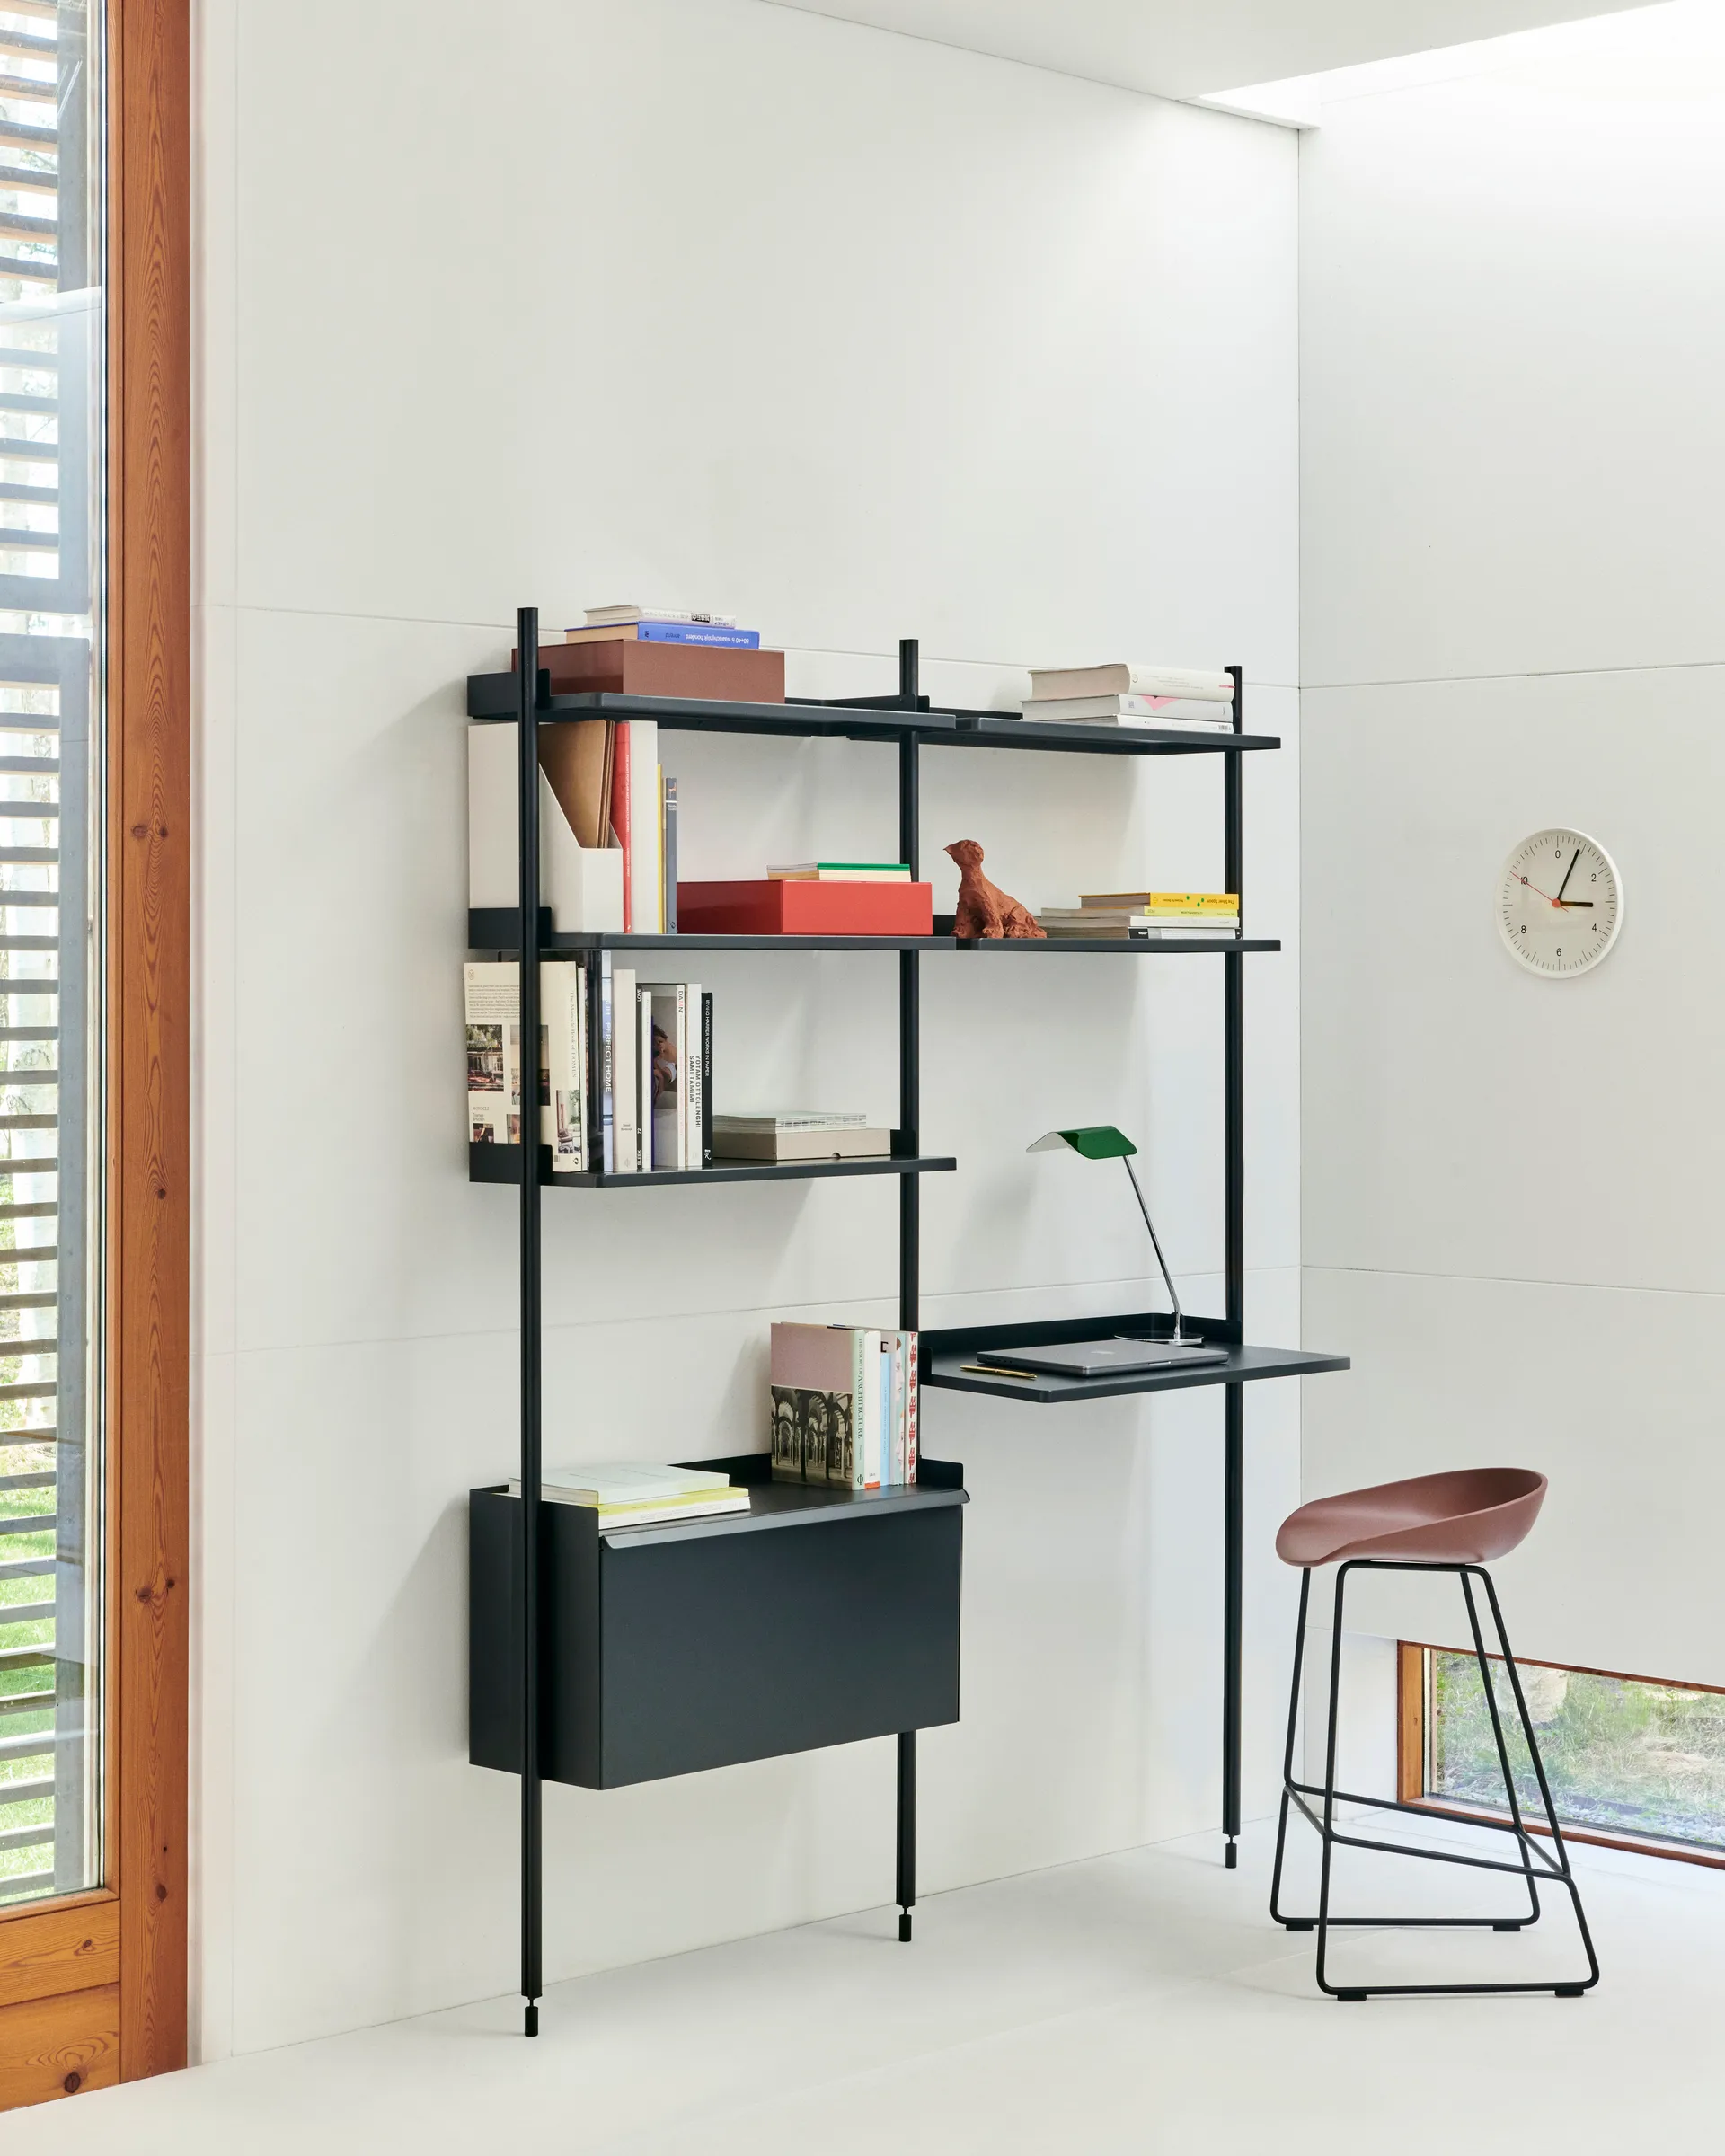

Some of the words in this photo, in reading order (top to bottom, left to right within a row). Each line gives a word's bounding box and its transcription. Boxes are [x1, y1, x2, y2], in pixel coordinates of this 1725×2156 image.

[1555, 850, 1561, 859] 0
[1591, 873, 1597, 882] 2
[1520, 925, 1526, 933] 8
[1591, 923, 1597, 932] 4
[1556, 948, 1561, 956] 6
